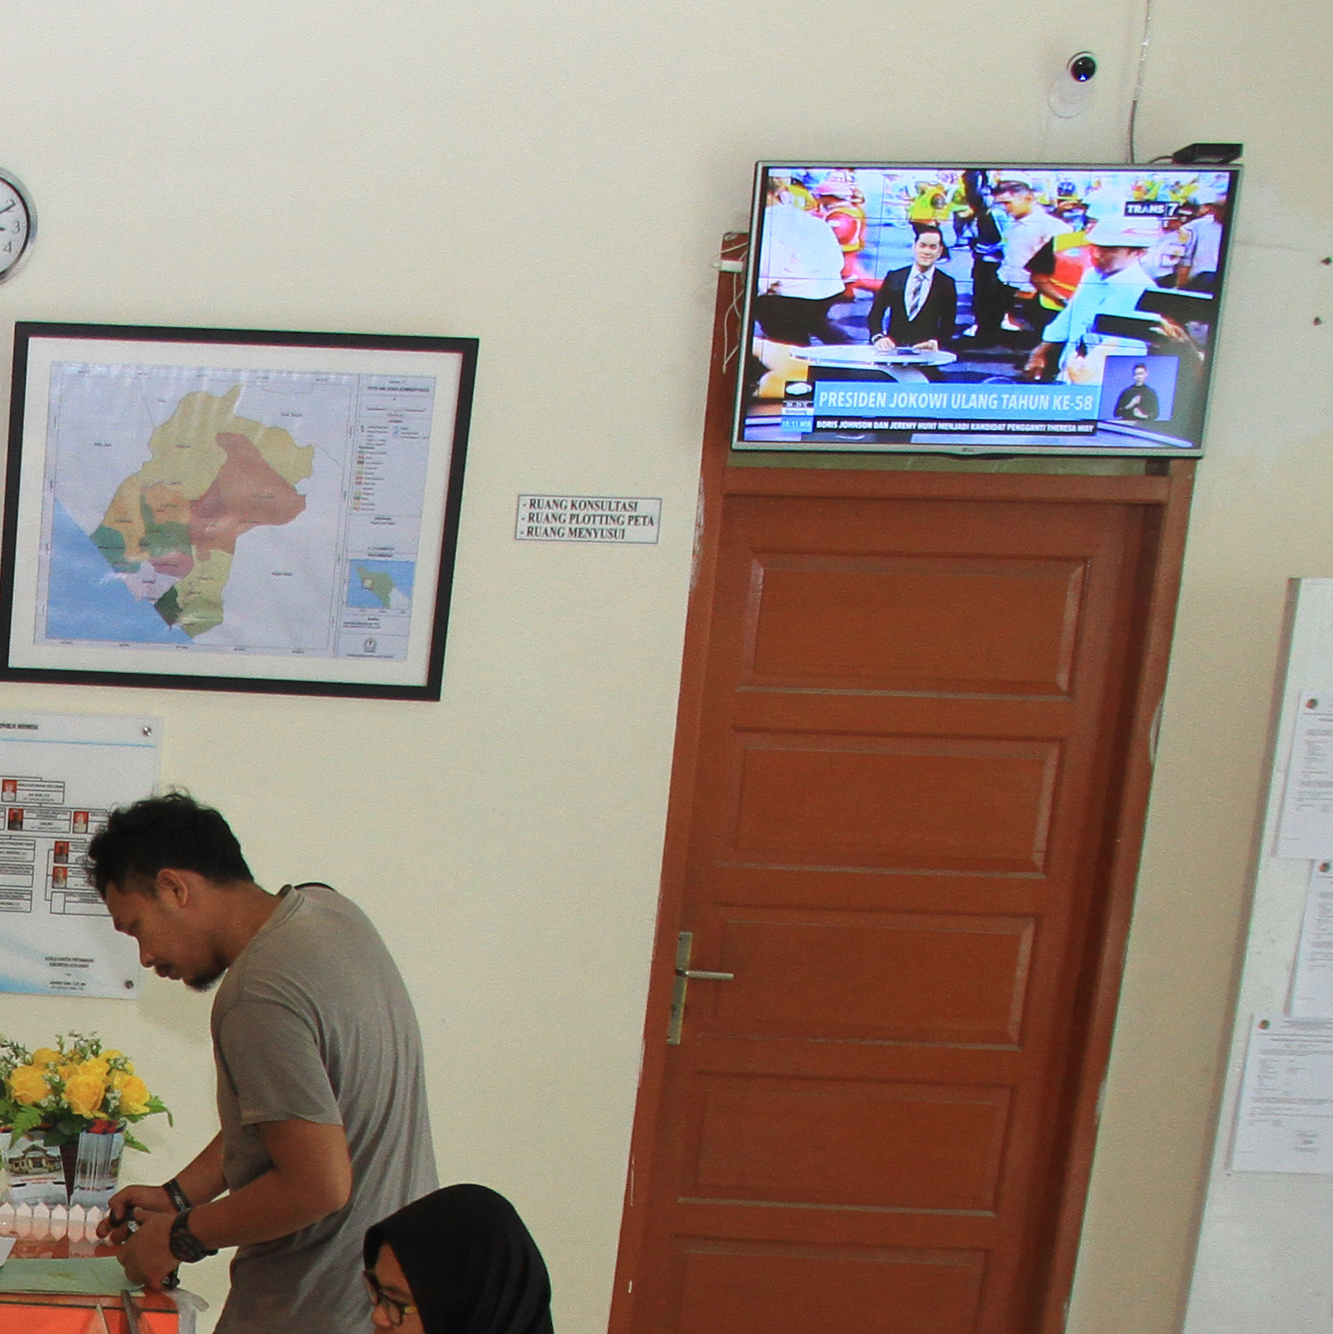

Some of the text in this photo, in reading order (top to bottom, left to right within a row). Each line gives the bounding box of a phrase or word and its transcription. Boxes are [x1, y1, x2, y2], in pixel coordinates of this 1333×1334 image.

[1127, 202, 1179, 216] TRANS 7
[11, 221, 20, 234] 3
[3, 241, 12, 253] 4
[819, 391, 887, 408] PRESIDEN
[889, 392, 948, 409] JOKOWI
[951, 393, 998, 409] ULANG
[1001, 394, 1049, 410] TAHUN
[1052, 395, 1094, 411] KE-58
[816, 420, 838, 429] BORIS
[839, 420, 873, 429] JOHNSON
[874, 421, 889, 429] DAN
[890, 421, 916, 430] JEREMY
[918, 421, 937, 430] HUNT
[529, 498, 639, 512] RUANG KONSULTASI
[527, 512, 654, 527] RUANG PLOTTING PETA
[526, 526, 626, 540] RUANG MENYUSUI
